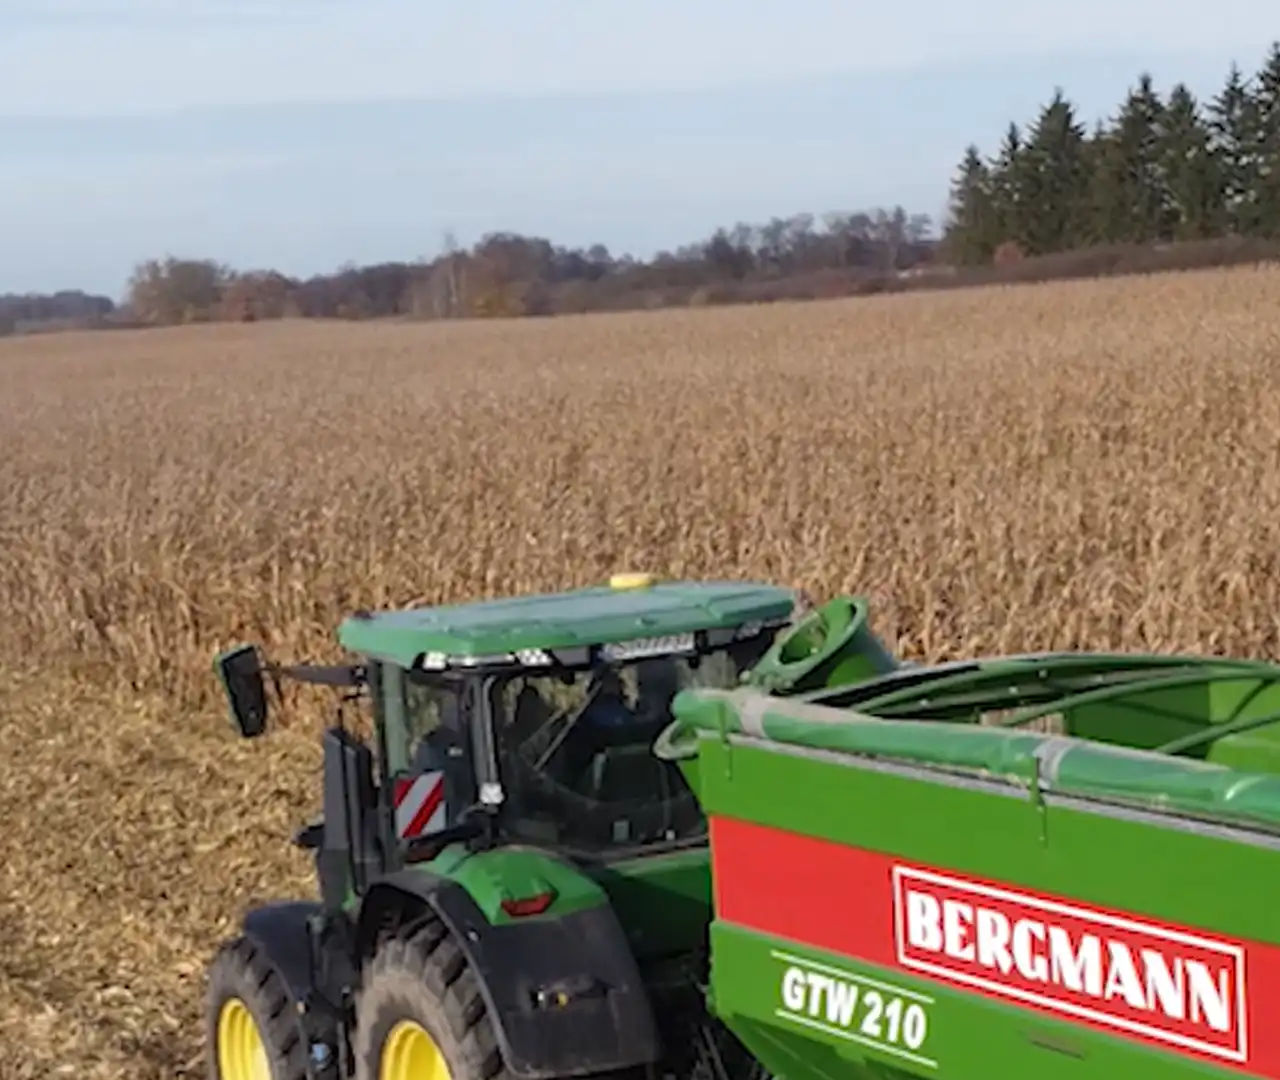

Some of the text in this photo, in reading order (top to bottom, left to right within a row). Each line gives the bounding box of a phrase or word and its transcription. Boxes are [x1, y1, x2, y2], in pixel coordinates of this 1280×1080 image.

[782, 966, 927, 1049] GTW 210
[906, 889, 1229, 1032] BERGMANN
